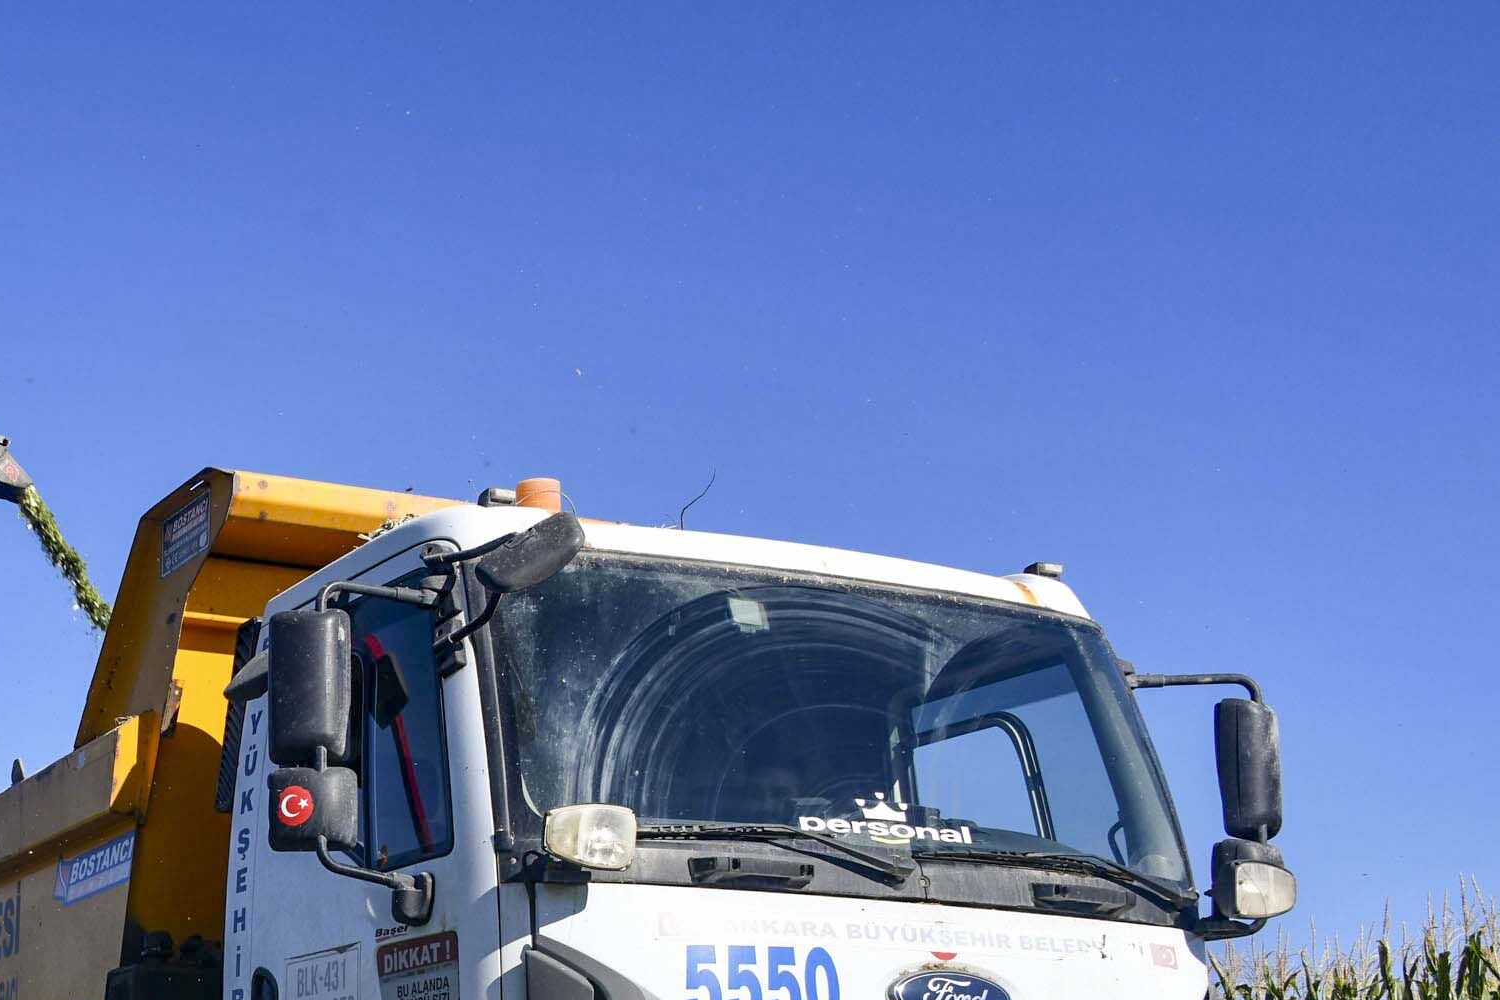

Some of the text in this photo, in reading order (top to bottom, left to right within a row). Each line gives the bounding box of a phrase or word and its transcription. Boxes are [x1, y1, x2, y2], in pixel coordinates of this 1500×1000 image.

[799, 816, 972, 844] personal
[69, 836, 135, 885] BOSTANCI
[384, 943, 440, 973] DİKKAT
[297, 959, 347, 998] BLK-431
[397, 976, 450, 999] BU ALANDA
